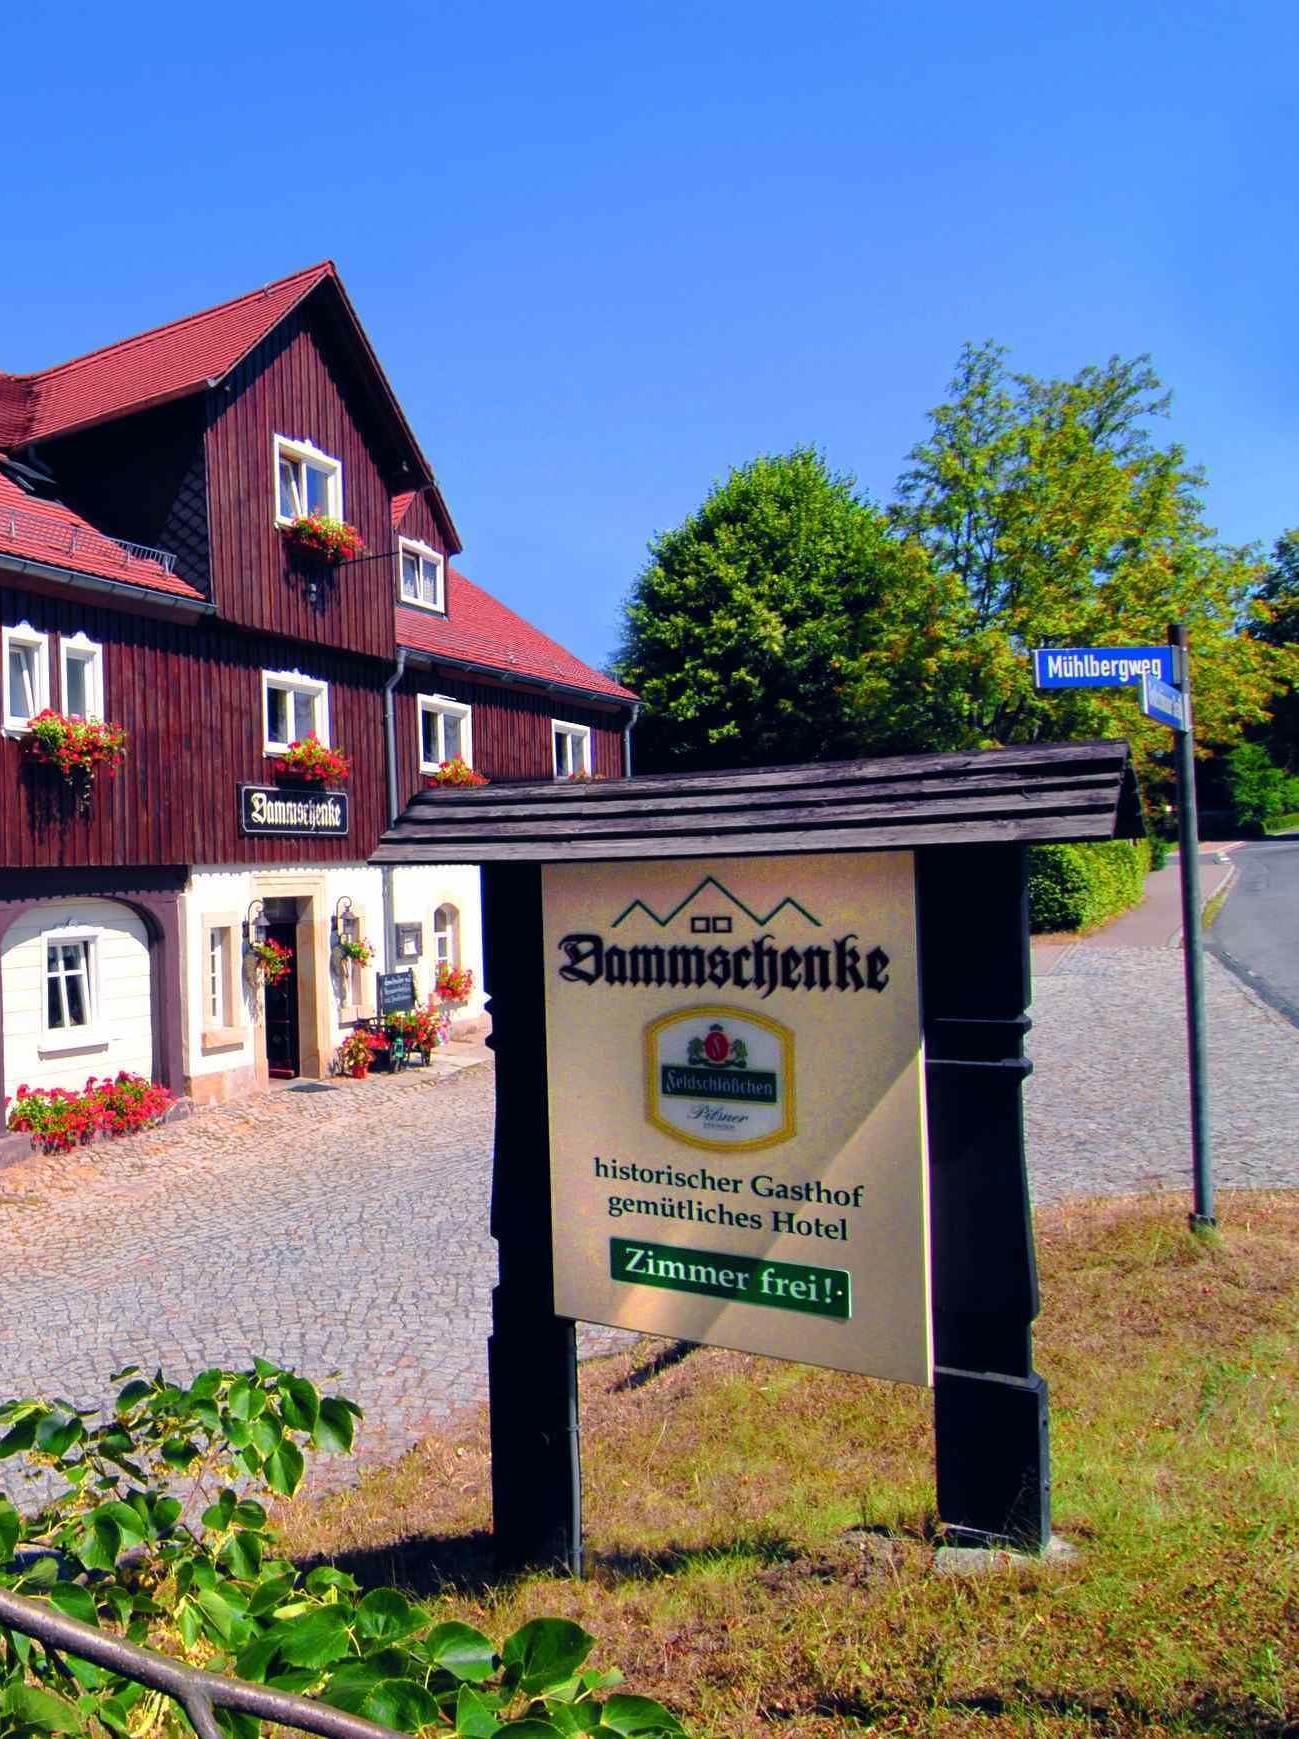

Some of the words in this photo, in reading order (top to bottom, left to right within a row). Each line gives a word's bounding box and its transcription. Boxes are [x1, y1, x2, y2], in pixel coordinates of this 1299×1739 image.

[1047, 654, 1162, 683] Mühlbergweg
[251, 792, 341, 831] Dammschenke
[557, 933, 891, 1000] Dammschenke
[687, 1104, 749, 1123] Pilsner
[594, 1157, 743, 1194] historischer
[751, 1175, 864, 1208] Gasthof
[608, 1195, 763, 1230] gemütliches
[772, 1211, 848, 1241] Hotel
[625, 1247, 750, 1290] Zimmer
[761, 1267, 833, 1304] frei!
